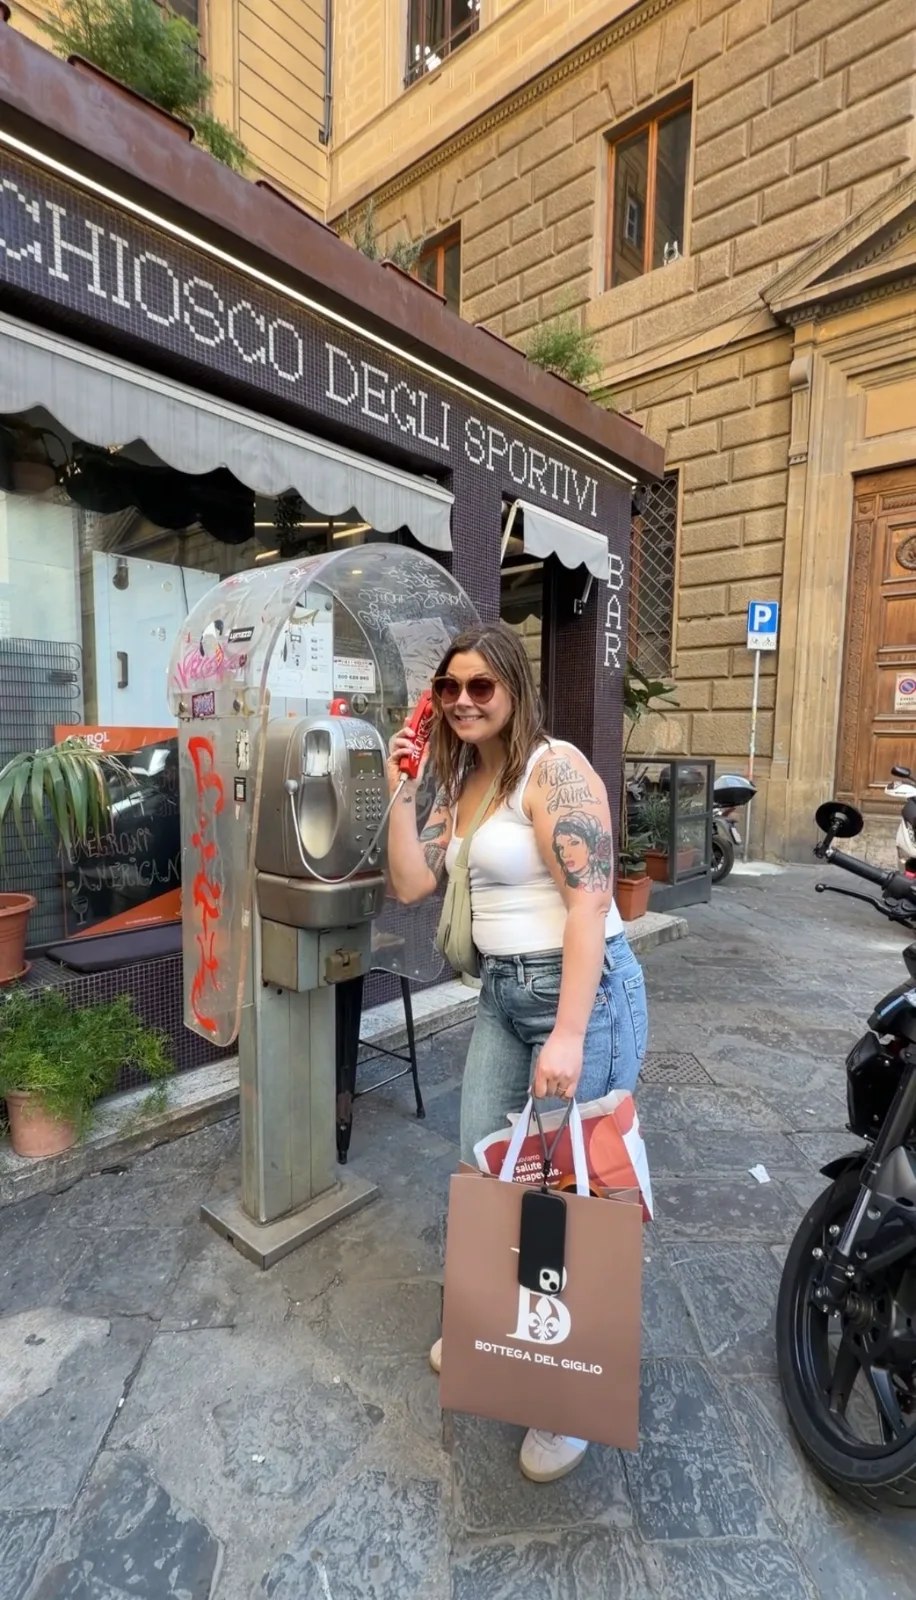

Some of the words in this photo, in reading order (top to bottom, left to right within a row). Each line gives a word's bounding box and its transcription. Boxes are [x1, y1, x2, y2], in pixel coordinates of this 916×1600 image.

[0, 179, 304, 382] CHIOSCO
[325, 342, 451, 452] DEGLI
[464, 416, 598, 517] SPORTIVI
[603, 553, 624, 668] BAR
[753, 604, 772, 631] P
[515, 1161, 542, 1173] salute
[474, 1340, 531, 1362] BOTTEGA
[533, 1353, 559, 1368] DEL
[560, 1358, 603, 1376] GIGLIO
